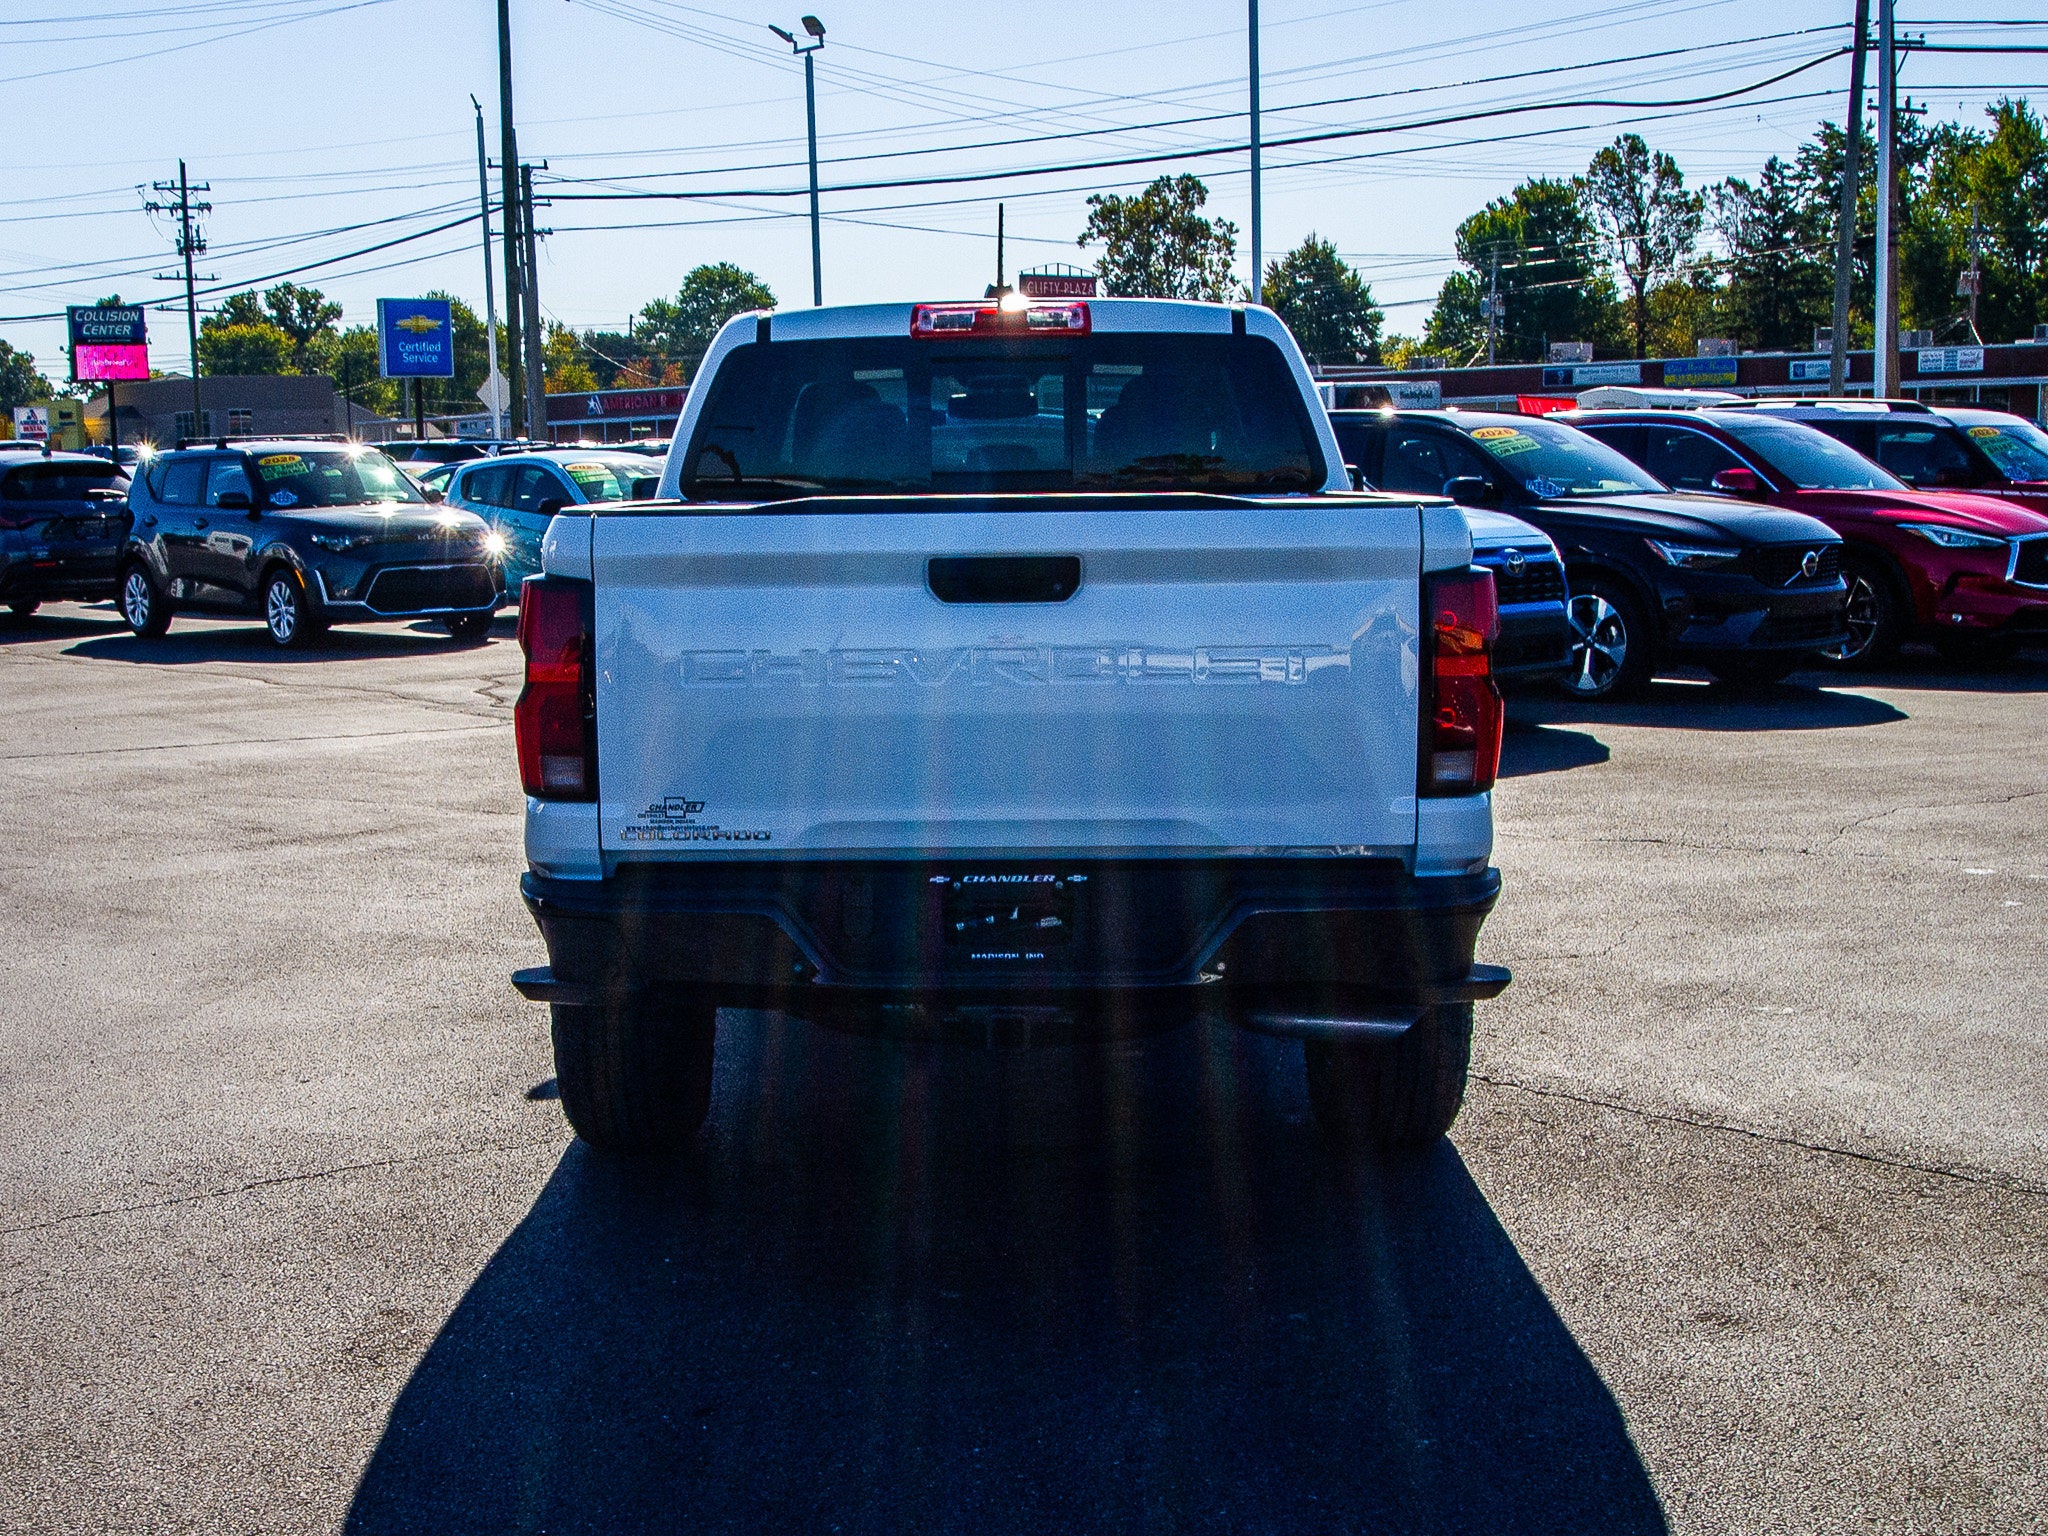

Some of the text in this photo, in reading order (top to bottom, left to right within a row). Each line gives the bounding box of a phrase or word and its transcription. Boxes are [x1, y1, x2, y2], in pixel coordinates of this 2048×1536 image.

[1026, 280, 1095, 295] CLIFTY PLAZA
[75, 309, 139, 322] COLLISION
[82, 323, 131, 335] CENTER
[398, 341, 441, 352] Certified
[402, 352, 438, 363] Service
[603, 395, 657, 410] AMERICAN
[1477, 428, 1513, 438] 2026
[679, 644, 1331, 687] CHEVROLET
[620, 831, 771, 841] COLORADO
[963, 874, 1056, 883] CHANDLER
